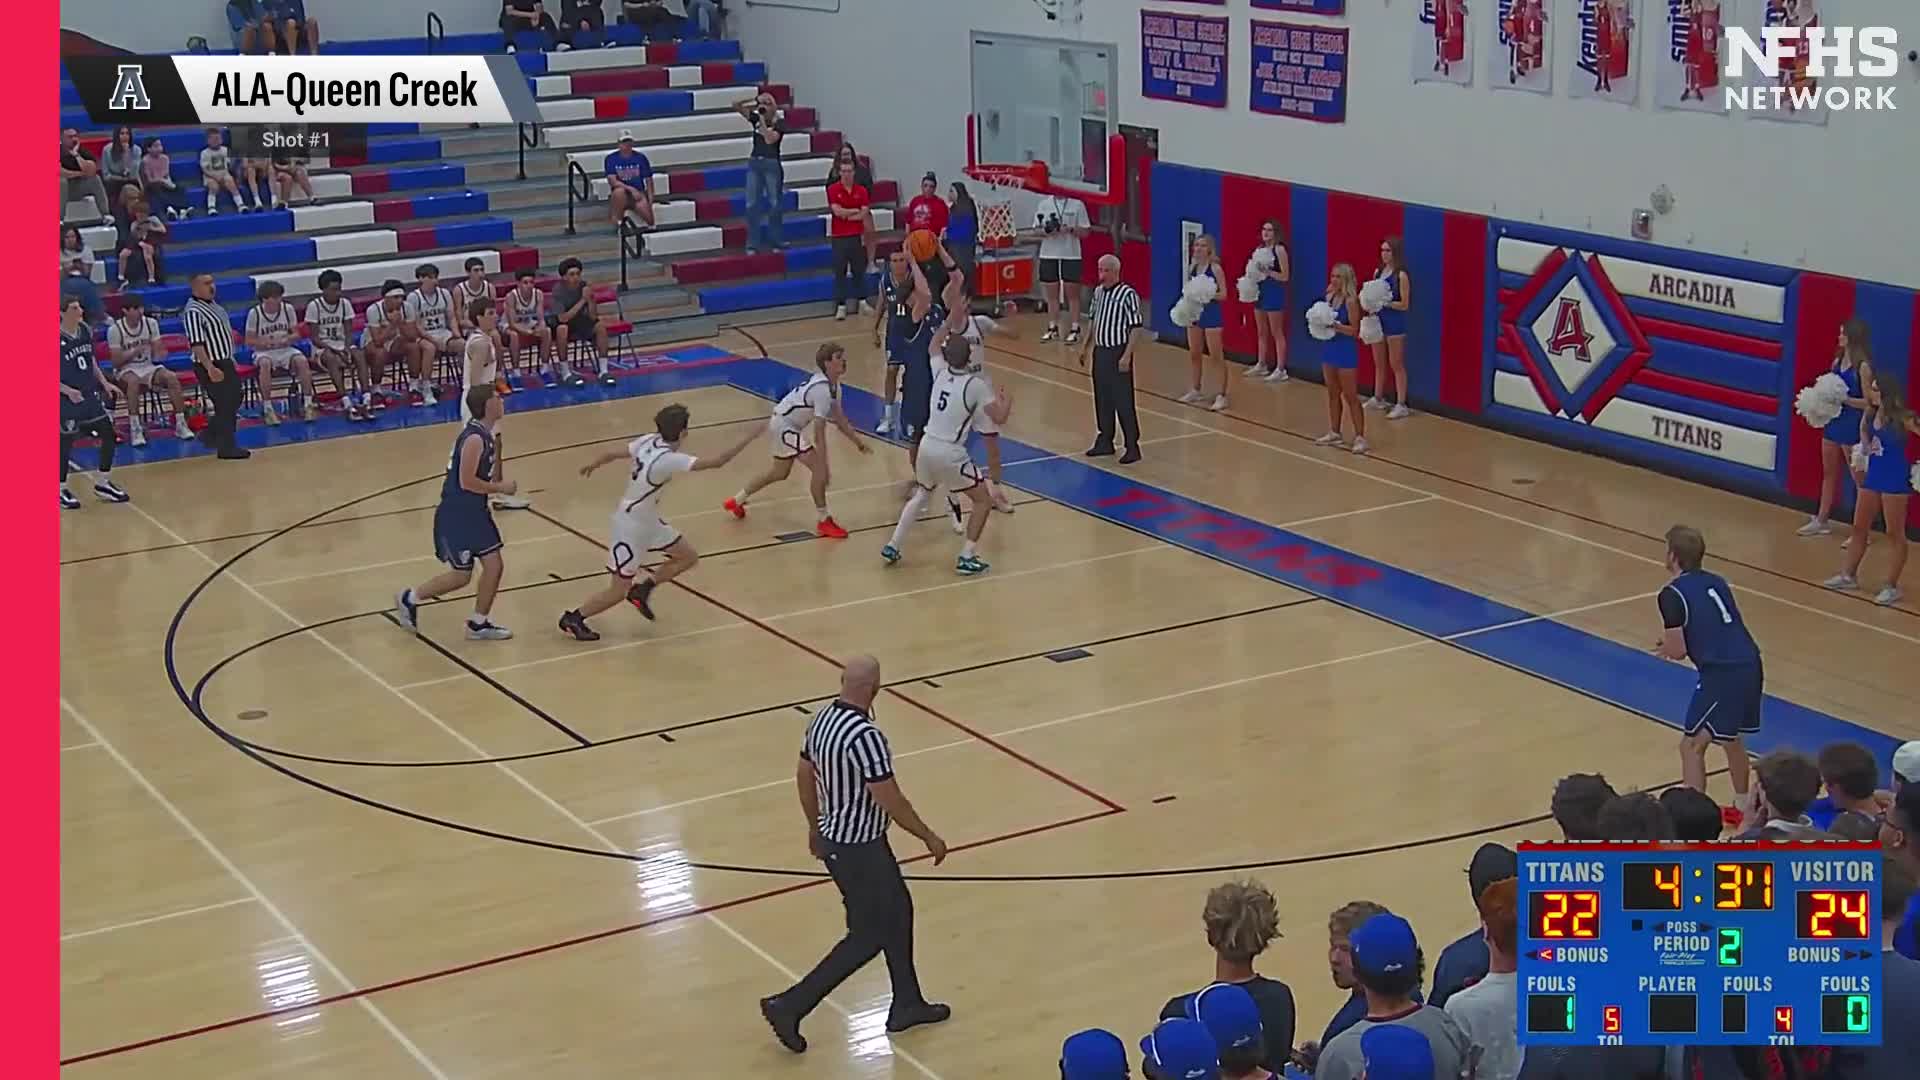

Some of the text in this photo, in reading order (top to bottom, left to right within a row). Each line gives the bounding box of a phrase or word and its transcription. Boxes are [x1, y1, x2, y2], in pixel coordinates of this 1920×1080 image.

[1002, 264, 1016, 279] G
[1649, 273, 1736, 309] ARCADIA
[1546, 297, 1594, 362] A
[77, 355, 88, 371] 0
[936, 390, 950, 412] 5
[1652, 416, 1723, 451] TITANS
[1707, 588, 1733, 624] 1
